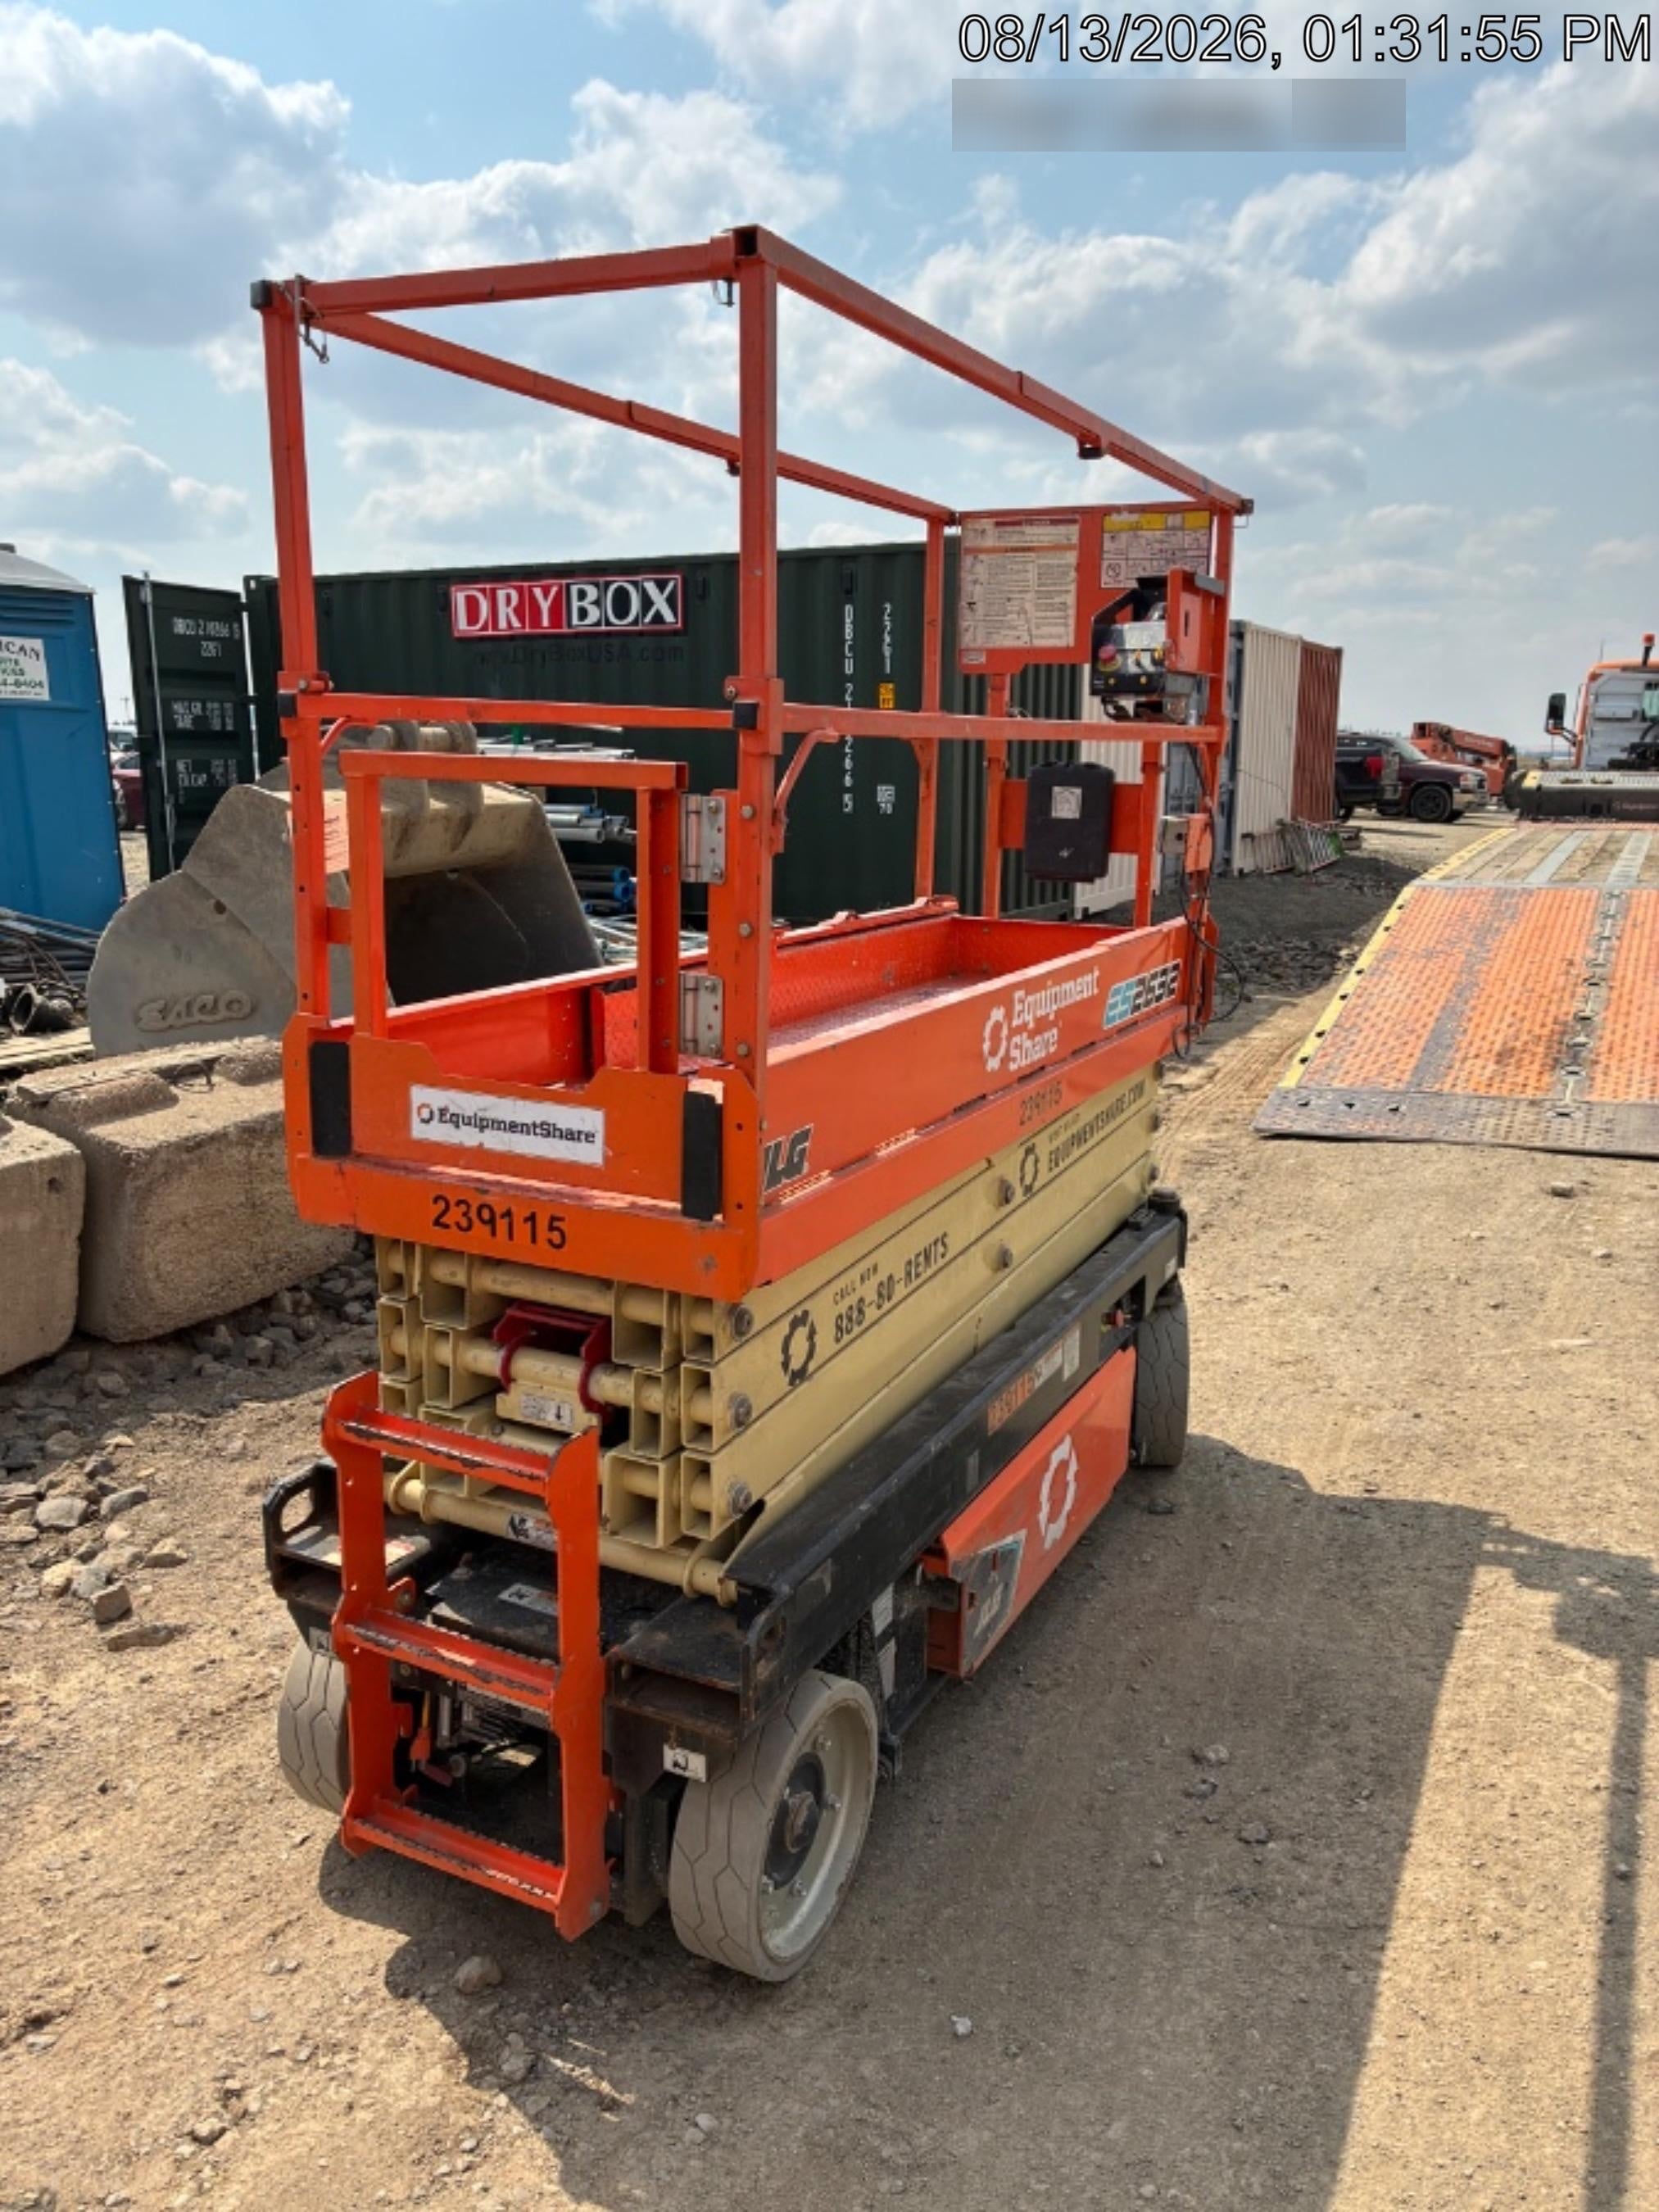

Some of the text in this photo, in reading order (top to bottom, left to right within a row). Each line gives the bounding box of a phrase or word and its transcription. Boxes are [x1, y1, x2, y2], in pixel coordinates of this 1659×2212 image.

[454, 579, 678, 630] DRYBOX
[1012, 966, 1100, 1030] Equipment
[1009, 1026, 1058, 1072] Share
[437, 1107, 596, 1145] EquipmentShare
[431, 1193, 567, 1250] 239115
[833, 1280, 856, 1306] CALL
[834, 1231, 949, 1344] 888-80-RENTS
